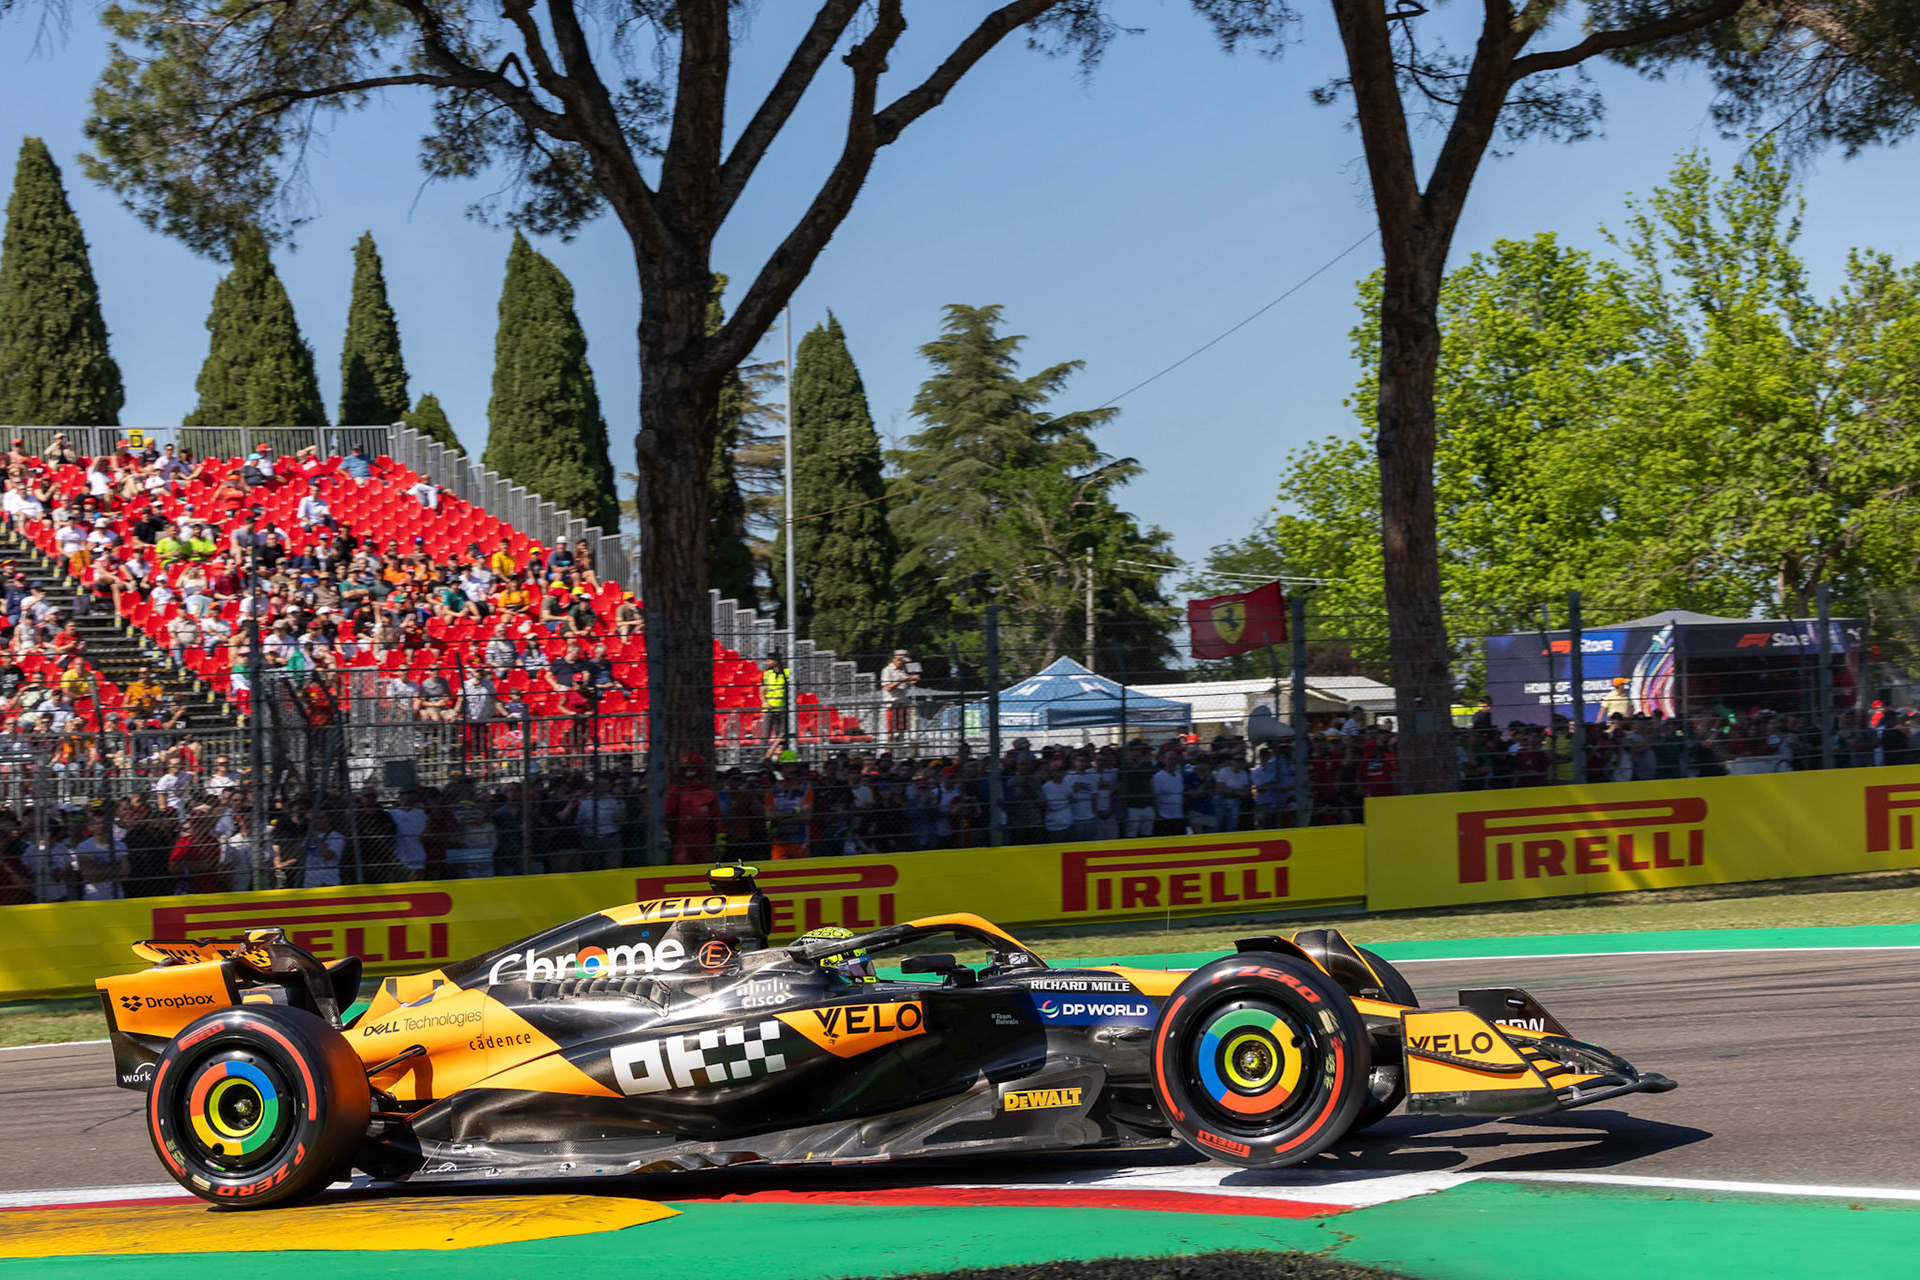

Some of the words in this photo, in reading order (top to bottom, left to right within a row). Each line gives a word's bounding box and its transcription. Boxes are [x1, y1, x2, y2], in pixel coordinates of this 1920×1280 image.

[1457, 797, 1708, 884] PIRELLI
[1061, 839, 1292, 912] PIRELLI
[636, 864, 898, 933] PELLI
[638, 896, 727, 921] VELO
[152, 892, 452, 962] PELLI
[489, 938, 685, 984] Chrome
[1030, 981, 1087, 991] RICHARD
[1091, 982, 1130, 992] MILLE
[1236, 965, 1322, 1003] ZERO
[145, 994, 216, 1009] Dropbox
[1062, 1004, 1086, 1016] DP
[1087, 1004, 1148, 1017] WORLD
[363, 1021, 400, 1037] DELL
[404, 1010, 482, 1031] Technologies
[813, 1003, 922, 1037] VELO
[1410, 1032, 1493, 1055] VELO
[1196, 1129, 1251, 1158] PIRELLI
[215, 1163, 290, 1196] ZERO
